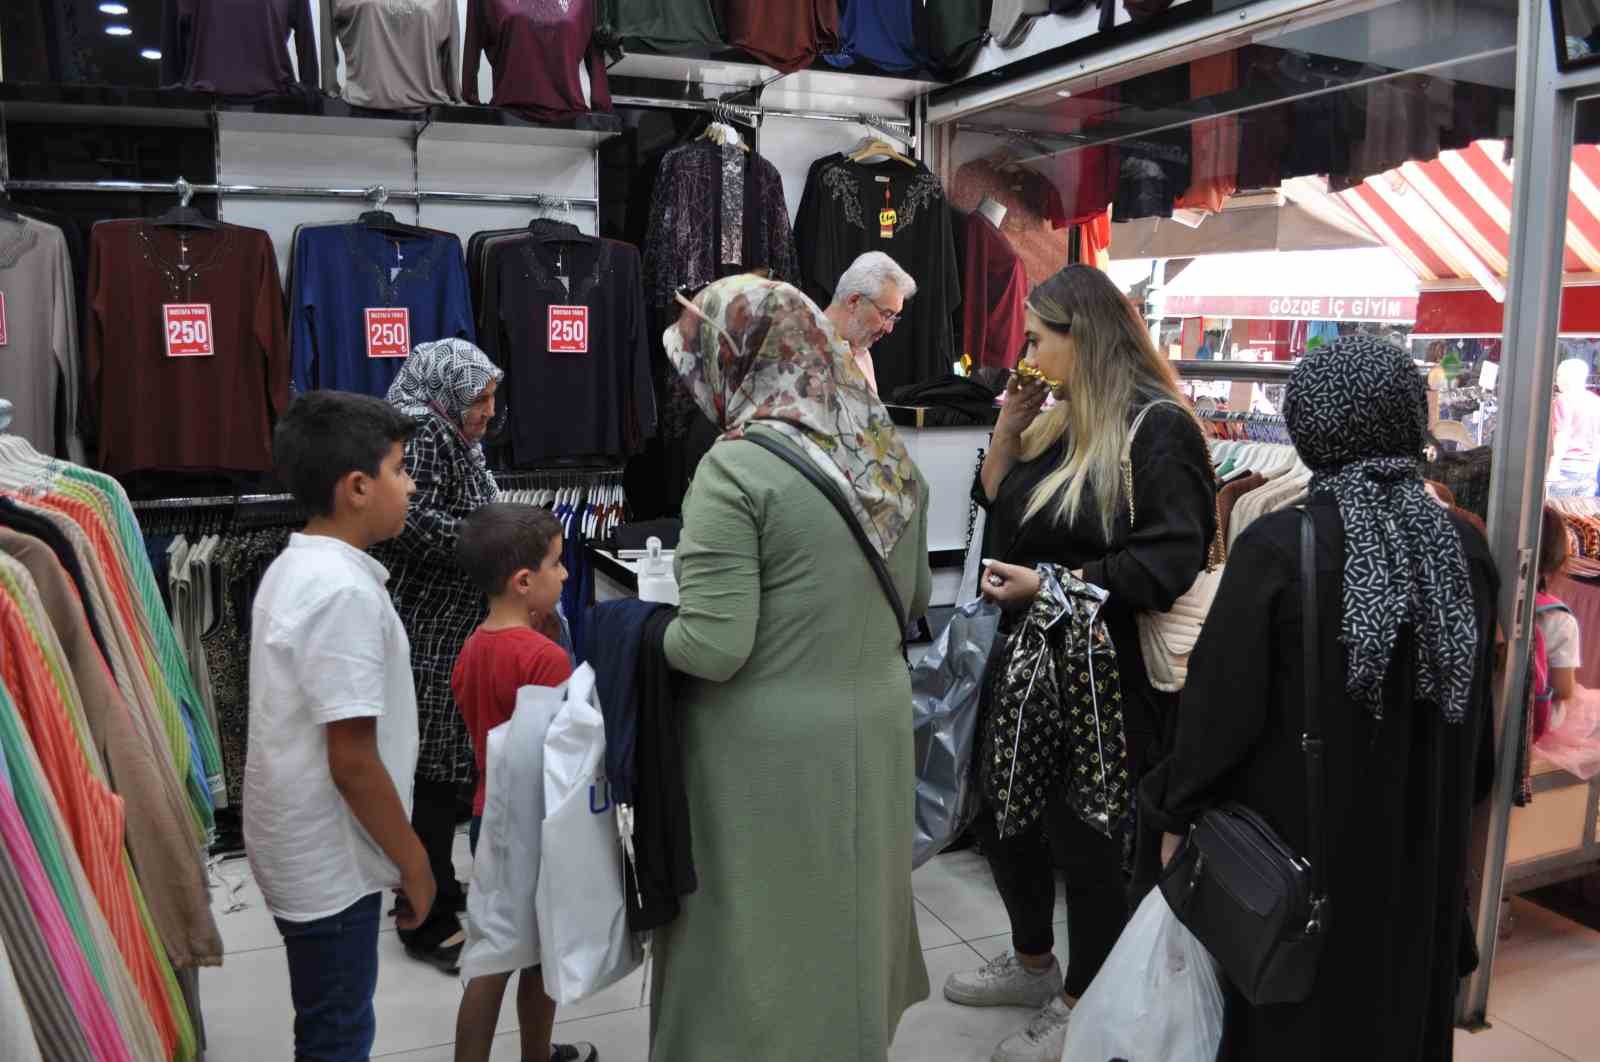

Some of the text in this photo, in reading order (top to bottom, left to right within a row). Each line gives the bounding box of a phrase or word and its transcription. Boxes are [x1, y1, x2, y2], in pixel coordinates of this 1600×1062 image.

[1269, 296, 1402, 318] GÖZDE İÇ GİYİM
[168, 320, 207, 344] 250
[371, 323, 405, 346] 250
[551, 319, 584, 342] 250
